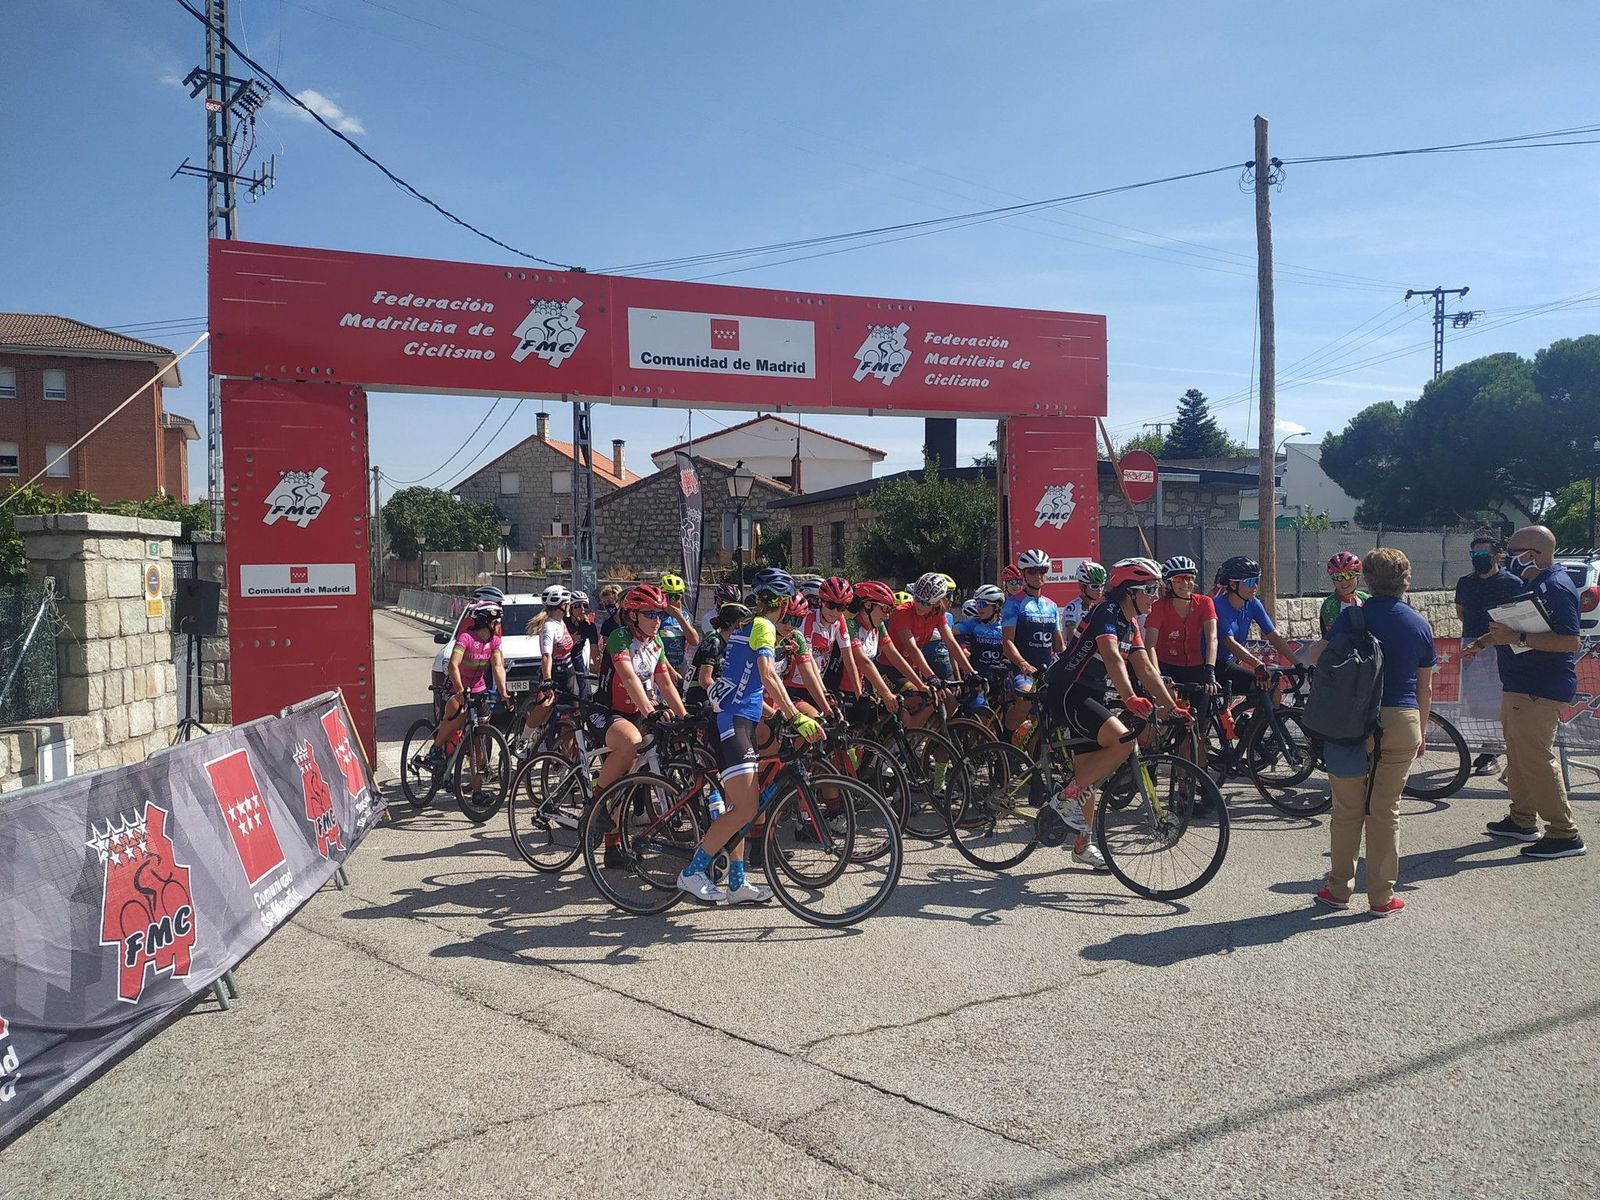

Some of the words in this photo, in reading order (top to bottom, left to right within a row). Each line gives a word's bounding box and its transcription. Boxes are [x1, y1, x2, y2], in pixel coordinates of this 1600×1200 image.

[372, 290, 495, 313] Federación
[339, 312, 458, 335] Madrileña
[468, 322, 496, 337] de
[520, 340, 575, 354] FMC
[923, 331, 1010, 349] Federación
[403, 341, 496, 361] Ciclismo
[640, 351, 728, 369] Comunidad
[732, 358, 751, 370] de
[756, 359, 806, 374] Madrid
[860, 361, 902, 373] FMC
[923, 352, 1005, 369] Madrileña
[1011, 358, 1031, 370] de
[924, 373, 990, 388] Ciclismo
[271, 505, 321, 516] FMC
[1039, 512, 1070, 520] FMC
[248, 587, 301, 595] Comunidad
[304, 586, 316, 594] de
[318, 585, 350, 593] Madrid
[511, 682, 528, 690] HRS
[731, 660, 754, 705] TREK
[316, 808, 337, 838] FMC
[125, 904, 192, 968] FMC
